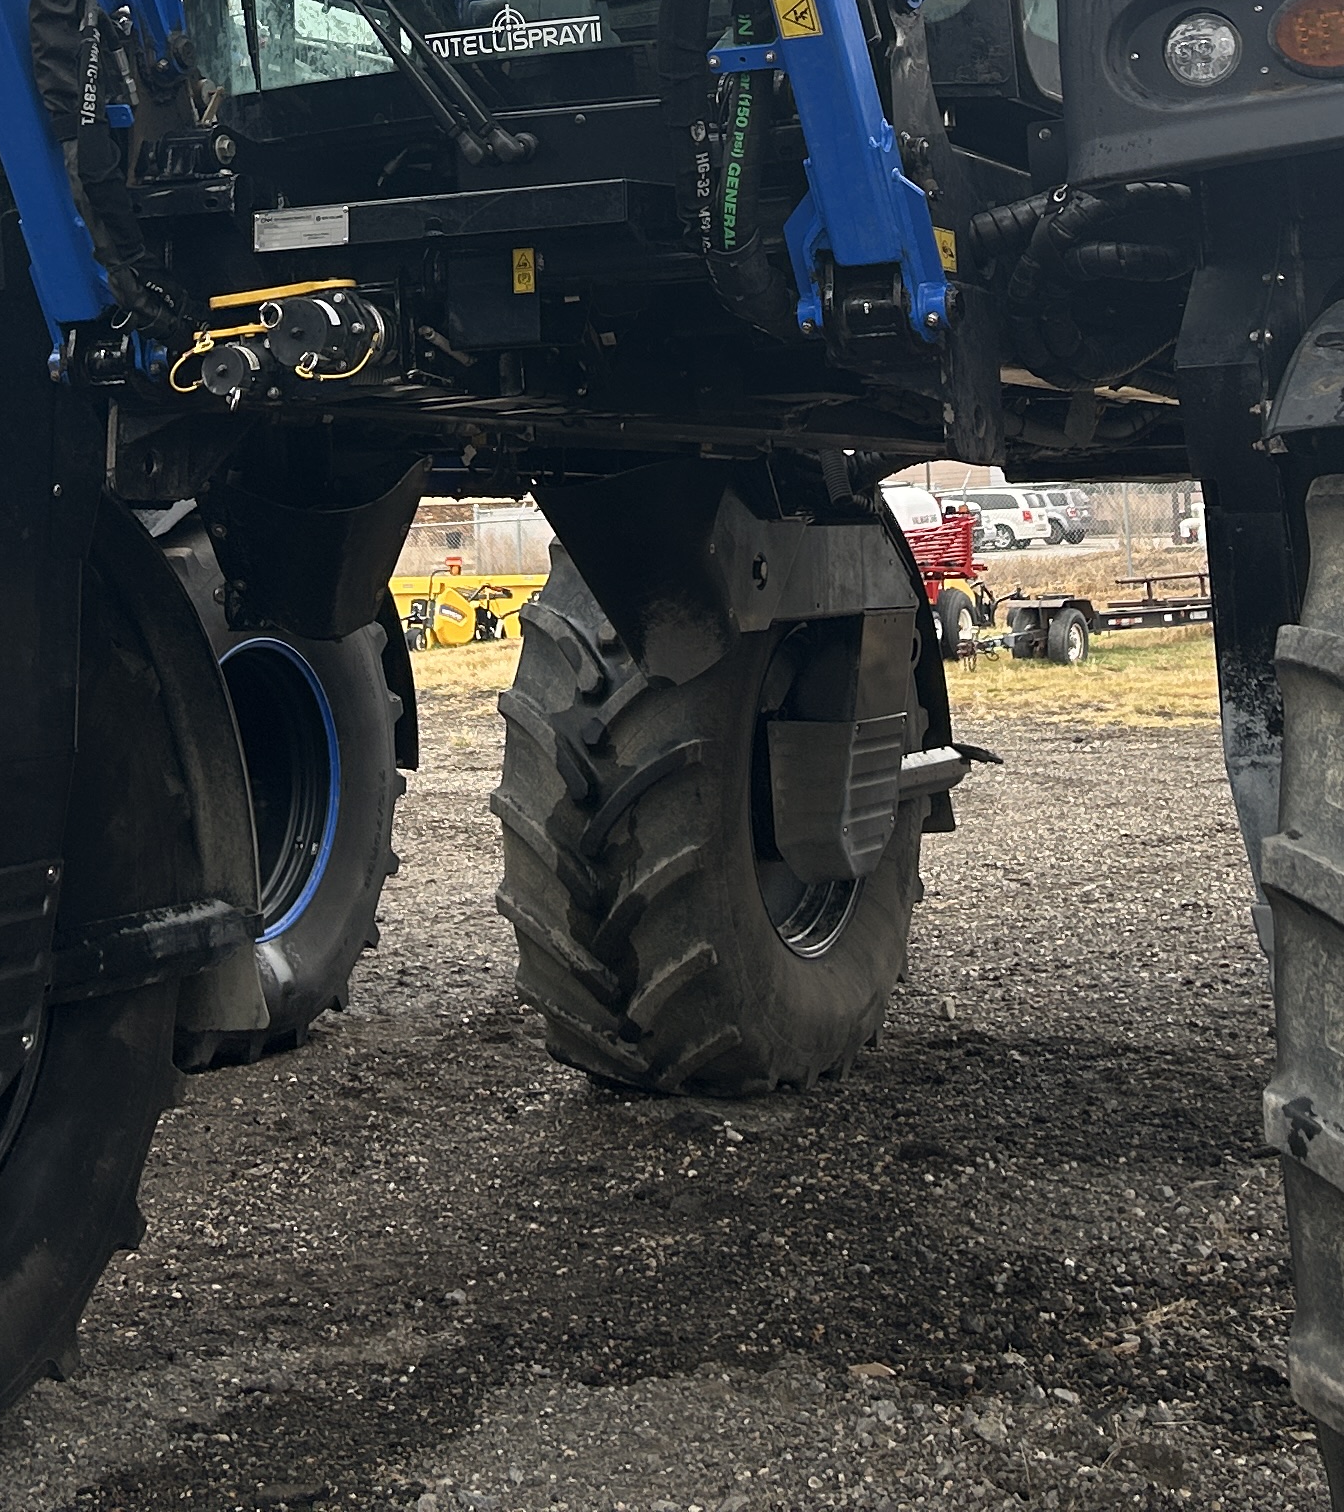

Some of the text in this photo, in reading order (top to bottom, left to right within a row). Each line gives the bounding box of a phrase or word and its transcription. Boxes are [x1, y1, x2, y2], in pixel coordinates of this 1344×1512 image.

[734, 94, 752, 128] (150
[695, 152, 711, 198] HG-32
[723, 162, 742, 250] GENERAL
